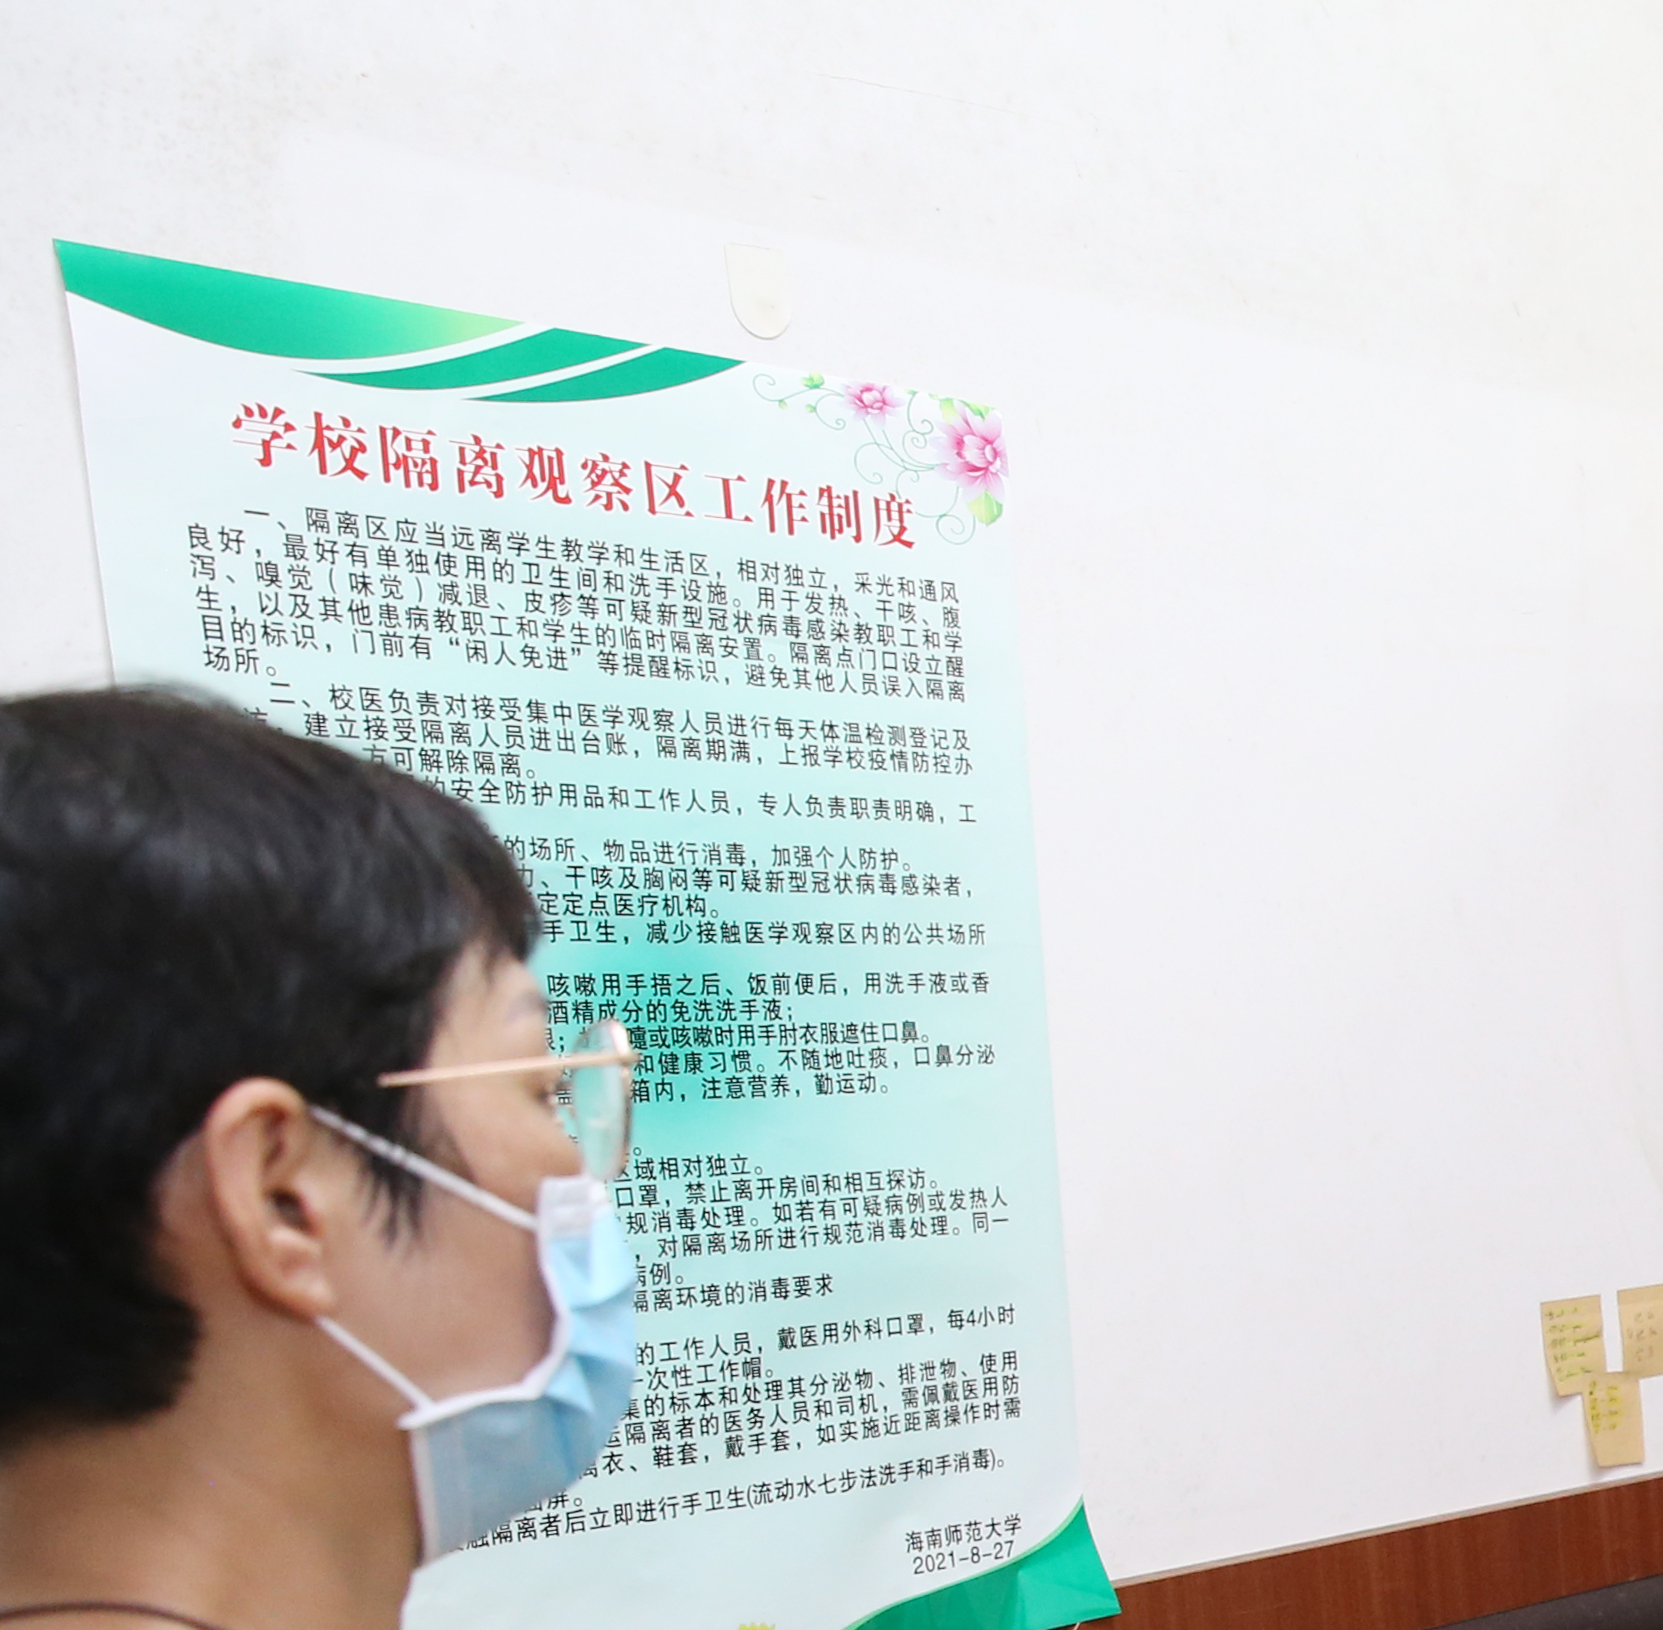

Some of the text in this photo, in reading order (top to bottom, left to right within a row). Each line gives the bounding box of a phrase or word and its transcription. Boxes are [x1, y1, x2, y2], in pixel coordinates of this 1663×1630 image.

[232, 402, 917, 550] 学校隔离观察区工作制度
[244, 507, 959, 604] 一、隔离区应当远离学生教学和生活区，相对独立，采光和通风
[188, 523, 961, 631] 良好，最好有单独使用的卫生间和洗手设施。用于发热、干咳、腹
[197, 585, 965, 679] 生，以及其他患病教职工和学生的临时隔离安置。隔离点门口设立醒
[203, 644, 277, 677] 场所。
[269, 682, 971, 751] 二、校医负责对接受集中医学观察人员进行每天体温检测登记及
[537, 891, 719, 919] 定定点医疗机构。
[542, 919, 987, 945] 手卫生，减少接触医学观察区内的公共场所
[547, 971, 990, 997] 咳嗽用手捂之后、饭前便后，用洗手液或香
[547, 997, 793, 1025] 酒精成分的免洗洗手液；
[630, 1072, 889, 1104] 箱内，注意营养，勤运动。
[614, 1166, 939, 1209] 口罩，禁止离开房间和相互探访。
[905, 1512, 1022, 1553] 海南师范大学
[912, 1539, 1015, 1575] 2021-8-27
